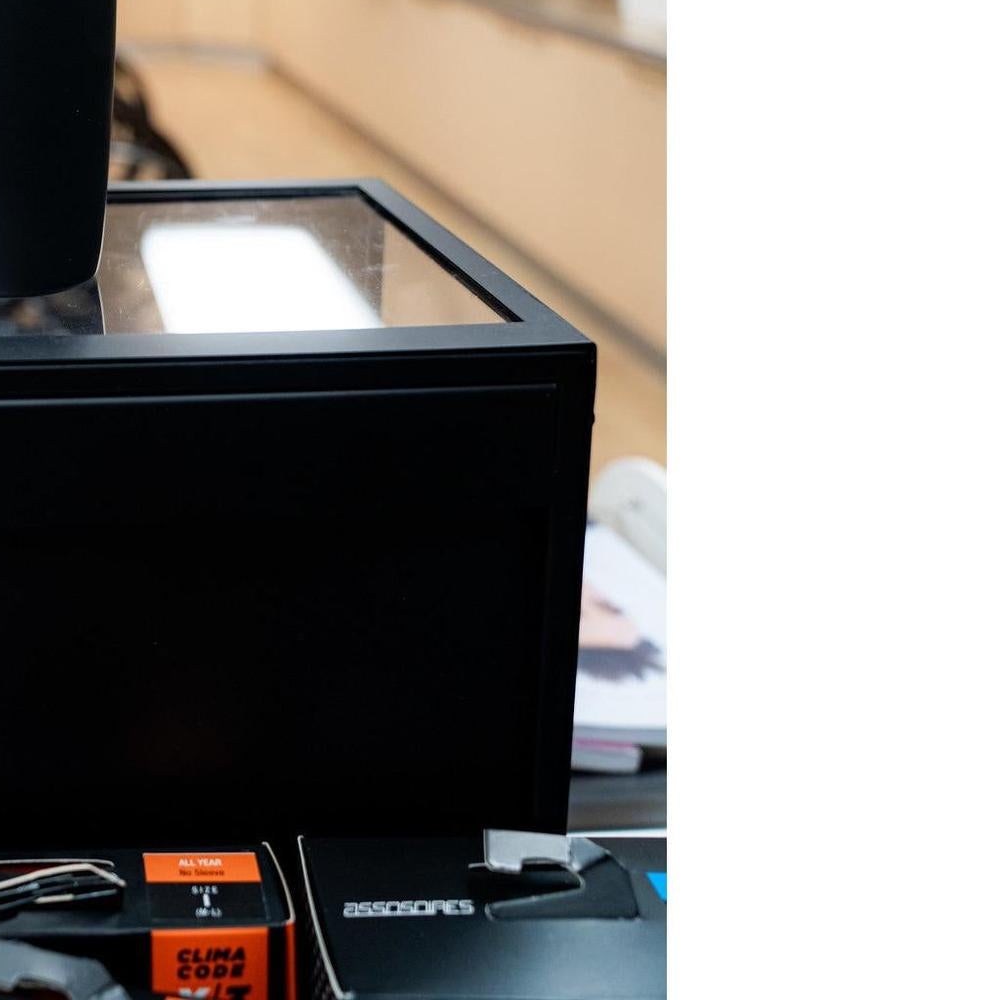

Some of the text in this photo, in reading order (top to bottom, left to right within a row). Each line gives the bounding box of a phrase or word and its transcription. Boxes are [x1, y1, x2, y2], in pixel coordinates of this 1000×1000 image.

[178, 858, 223, 868] ALL YEAR
[176, 946, 246, 964] CLIMA
[176, 963, 246, 981] CODE
